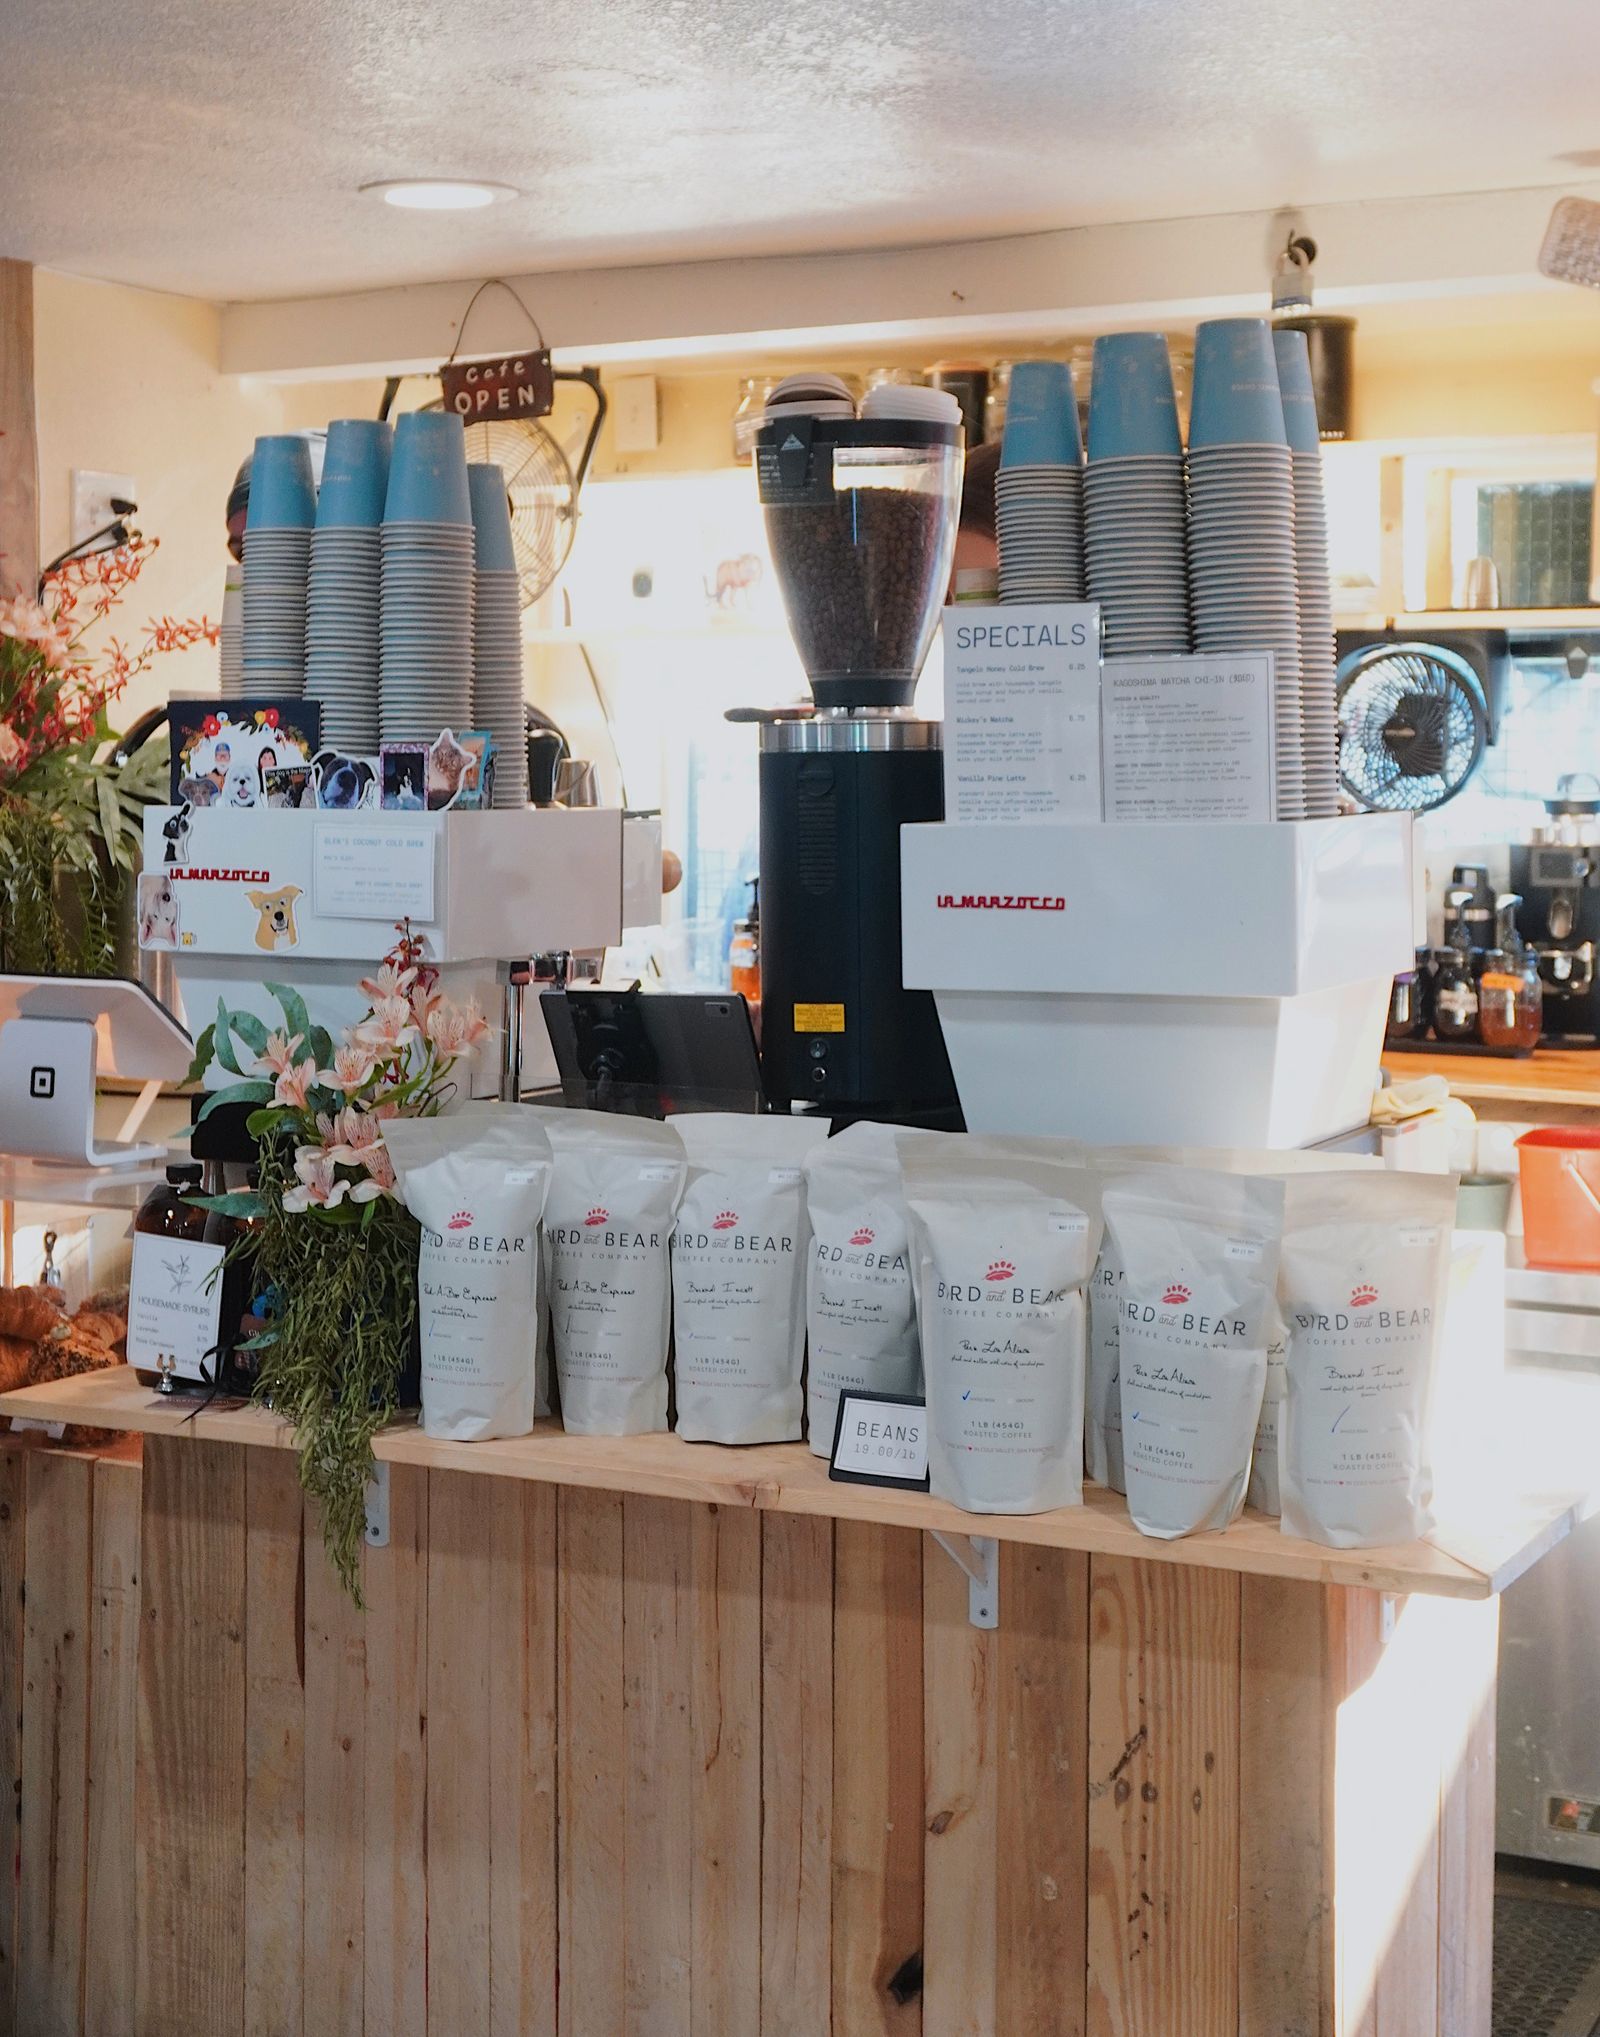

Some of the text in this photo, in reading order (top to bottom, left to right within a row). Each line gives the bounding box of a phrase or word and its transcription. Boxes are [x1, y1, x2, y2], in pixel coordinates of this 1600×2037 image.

[466, 361, 525, 384] Cafe
[454, 384, 534, 415] OPEN
[956, 624, 1086, 649] SPECIALS
[1113, 678, 1157, 687] KAGOSHIMA
[1161, 677, 1190, 686] MATCHA
[469, 1235, 525, 1252] BEAR
[605, 1232, 660, 1248] BEAR
[712, 1237, 730, 1249] and
[734, 1235, 792, 1252] BEAR
[455, 1256, 510, 1264] COMPANY
[865, 1252, 905, 1270] BEA
[850, 1273, 906, 1283] COMPANY
[937, 1282, 1066, 1305] BIRD and BEAR
[138, 1296, 210, 1316] HOUSEMADE SYRUPS
[943, 1307, 985, 1317] COFFEE
[1158, 1313, 1178, 1326] and
[1183, 1314, 1246, 1336] BEAR
[1296, 1308, 1431, 1331] BIRD and BEAR
[1167, 1335, 1227, 1349] COMPANY
[1306, 1337, 1355, 1346] COFFEE
[455, 1365, 480, 1373] COFFEE
[857, 1421, 919, 1442] BEANS
[964, 1430, 998, 1438] ROASTED
[854, 1443, 916, 1460] 19.00/lb
[1133, 1450, 1193, 1470] ROASTED COFFEE
[1144, 1444, 1153, 1452] LB
[1156, 1445, 1185, 1459] (454G)
[1333, 1463, 1372, 1471] ROASTED
